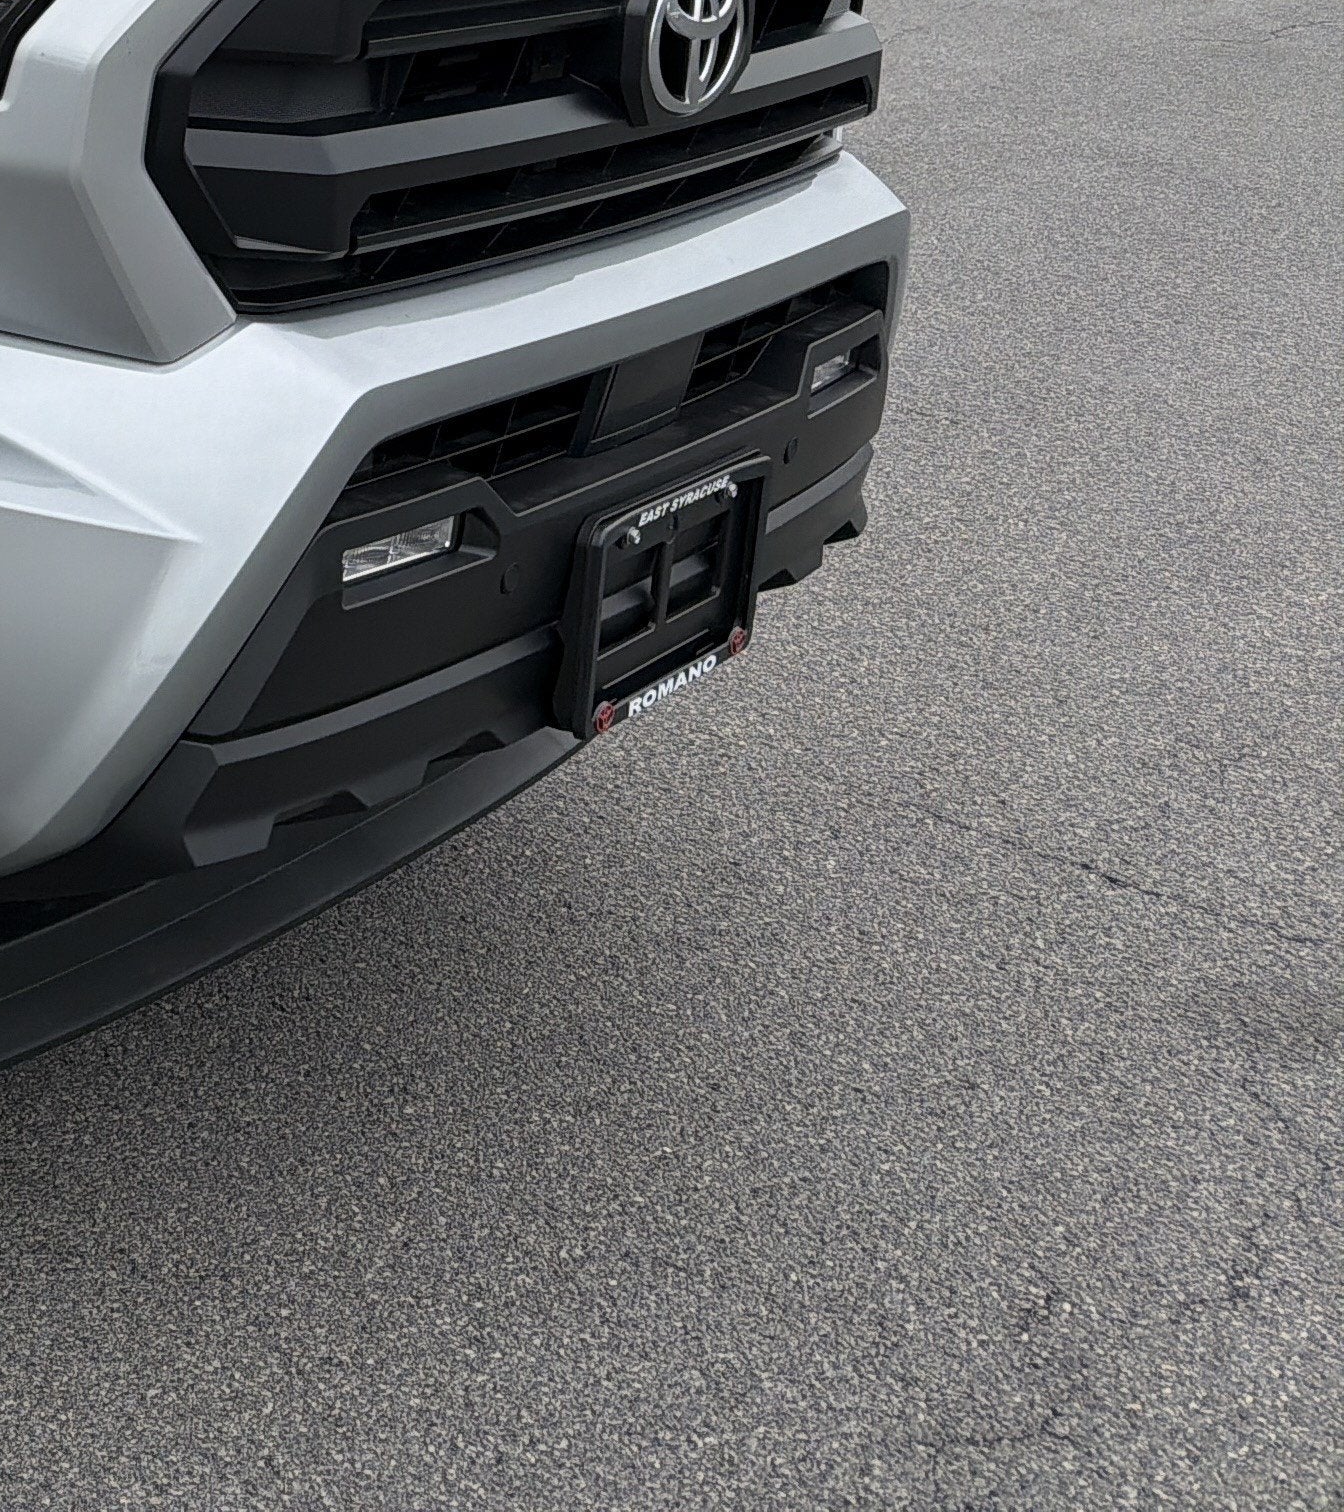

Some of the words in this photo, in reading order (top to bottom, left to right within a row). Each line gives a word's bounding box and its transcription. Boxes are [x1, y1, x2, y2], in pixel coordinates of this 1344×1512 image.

[638, 501, 671, 527] EAST
[670, 474, 730, 513] SYRACUSE
[627, 653, 718, 718] ROMANO
